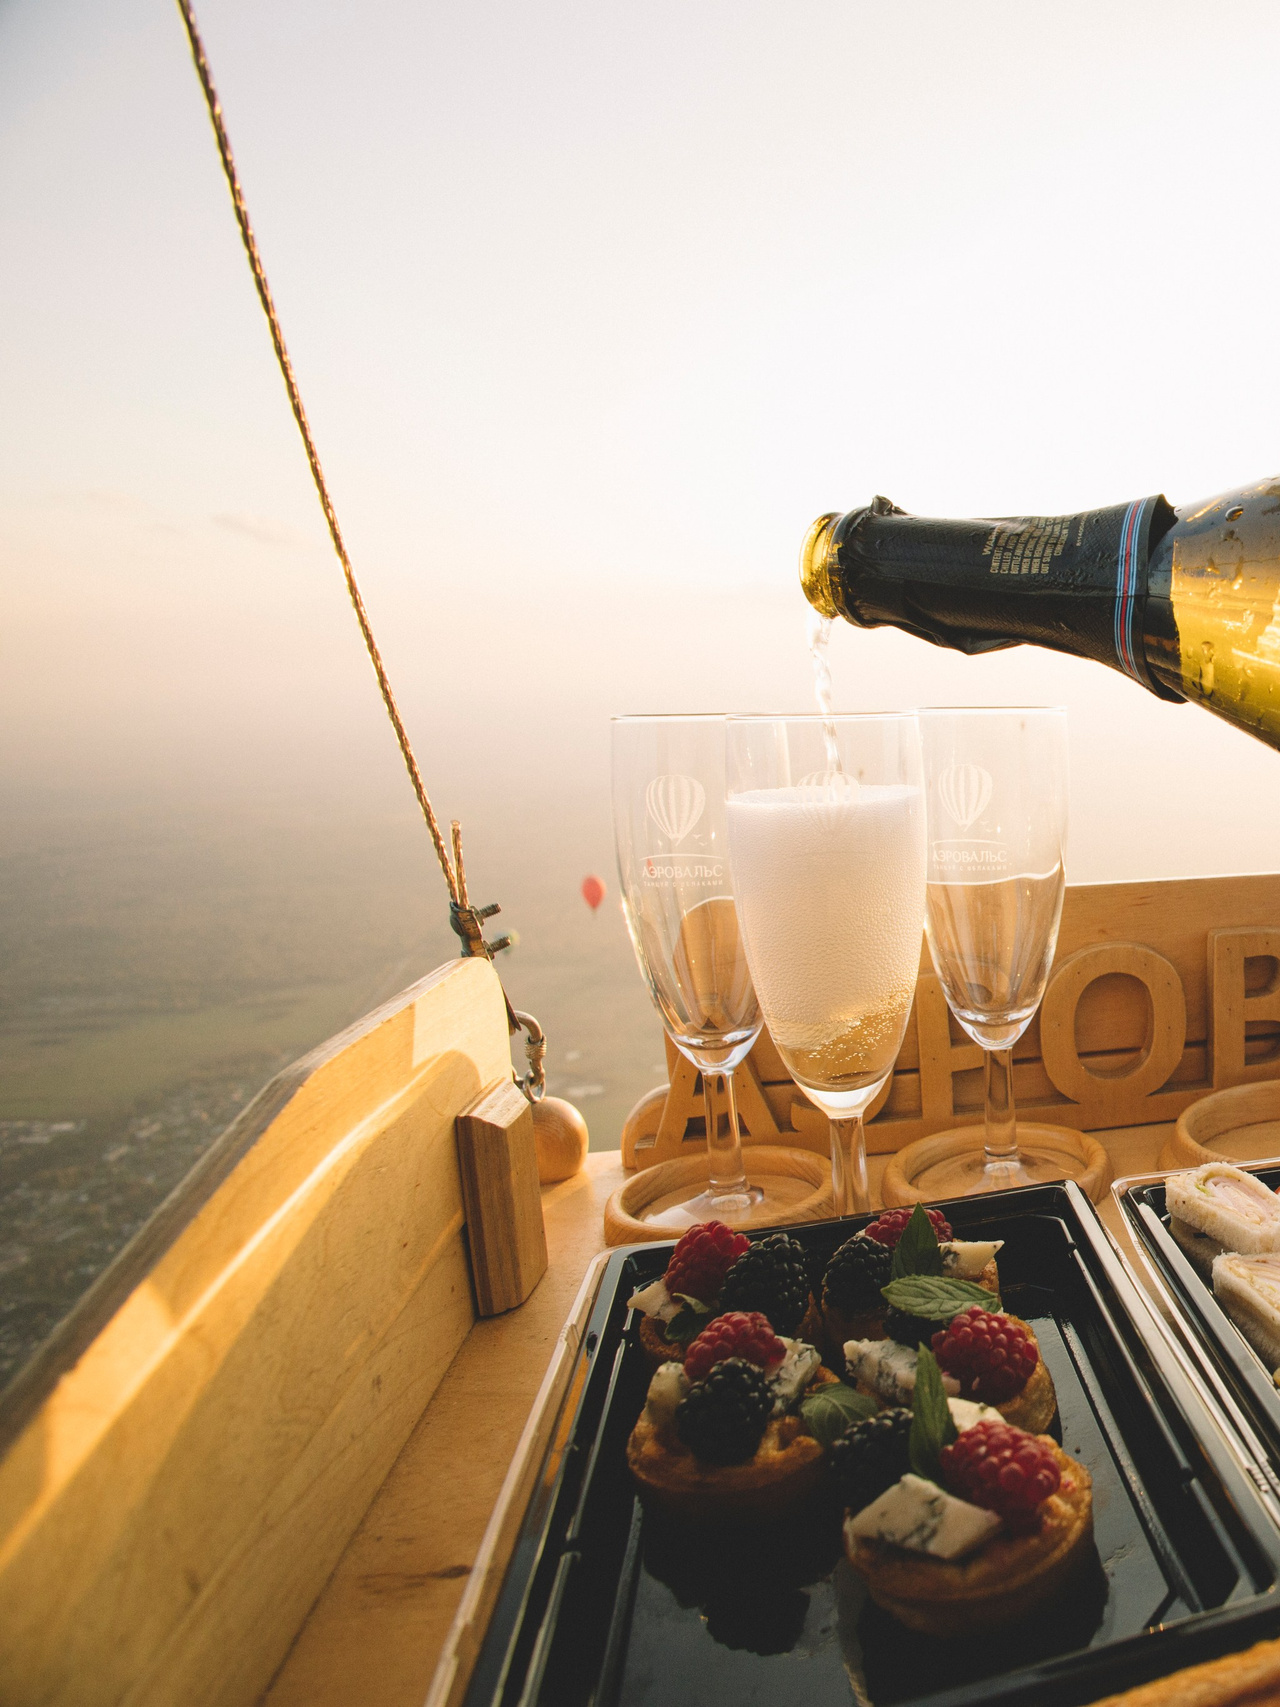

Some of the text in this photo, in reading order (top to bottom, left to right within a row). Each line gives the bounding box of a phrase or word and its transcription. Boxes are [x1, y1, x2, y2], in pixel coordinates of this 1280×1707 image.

[1011, 555, 1022, 574] BOTTLE
[1021, 557, 1031, 574] WHEN
[1041, 562, 1049, 573] OUT
[642, 864, 722, 878] АЭРОВАЛЬС
